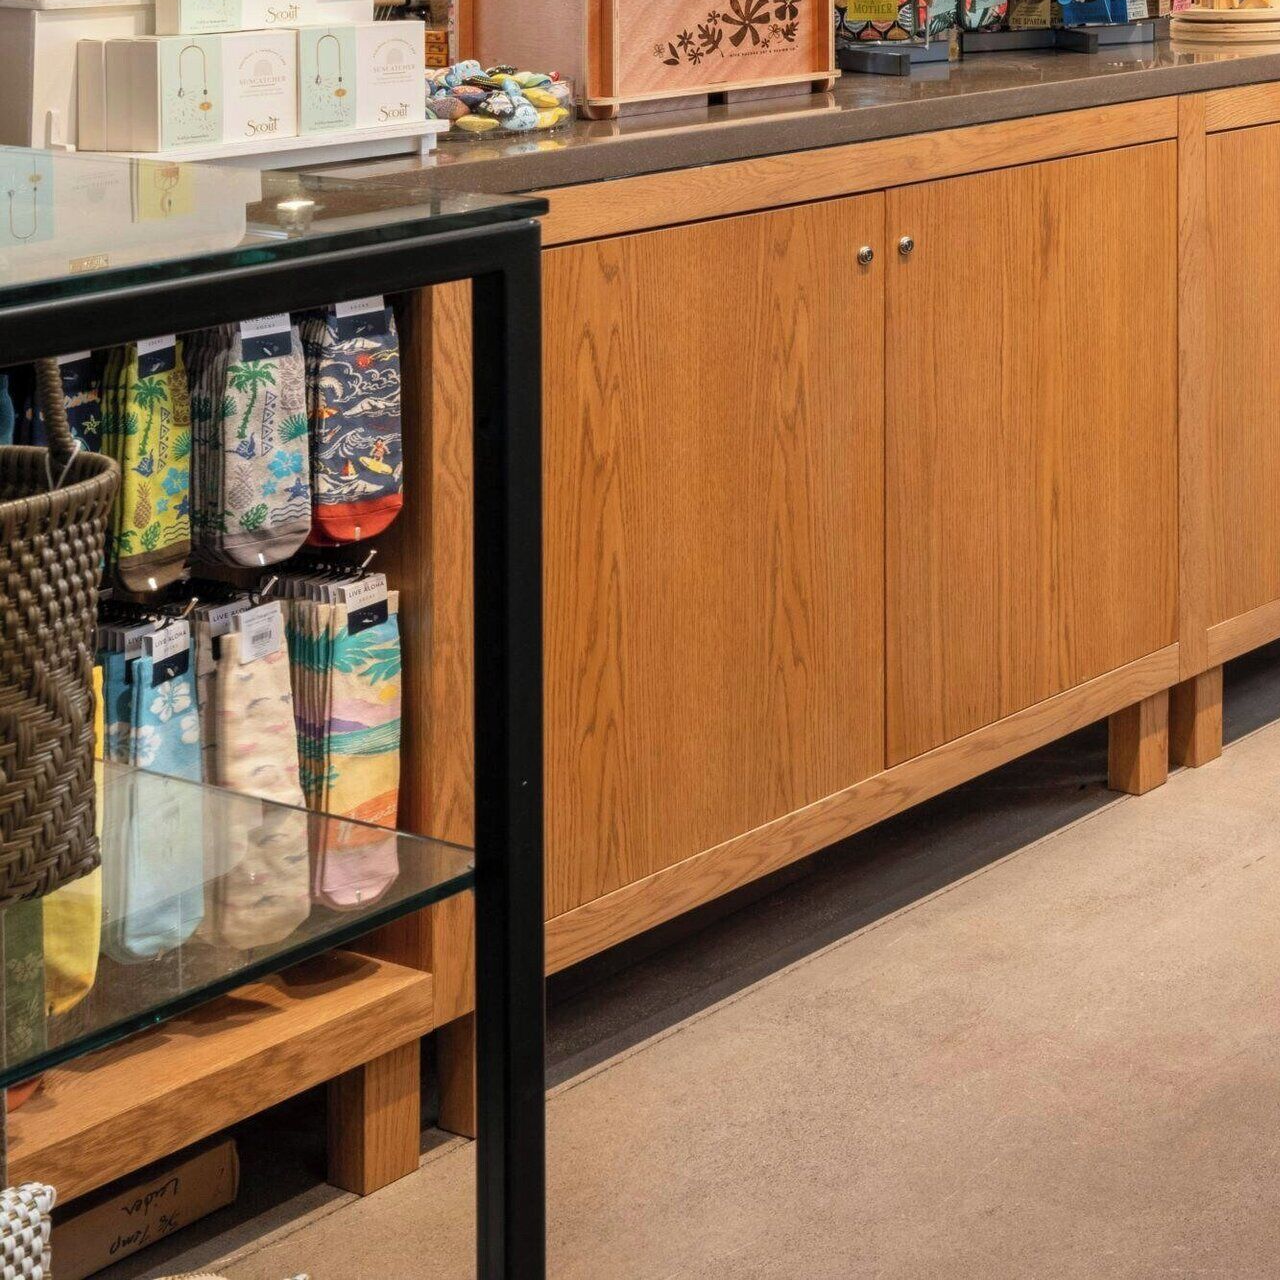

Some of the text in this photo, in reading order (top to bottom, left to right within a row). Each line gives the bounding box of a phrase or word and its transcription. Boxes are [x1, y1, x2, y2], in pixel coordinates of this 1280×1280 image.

[265, 3, 300, 24] Scout
[852, 2, 893, 14] MOTHER
[378, 102, 410, 122] Scout
[244, 116, 280, 137] Scout
[348, 580, 385, 598] LIVE ALOHA
[212, 612, 229, 623] LIVE
[154, 630, 188, 648] LIVE ALOHA
